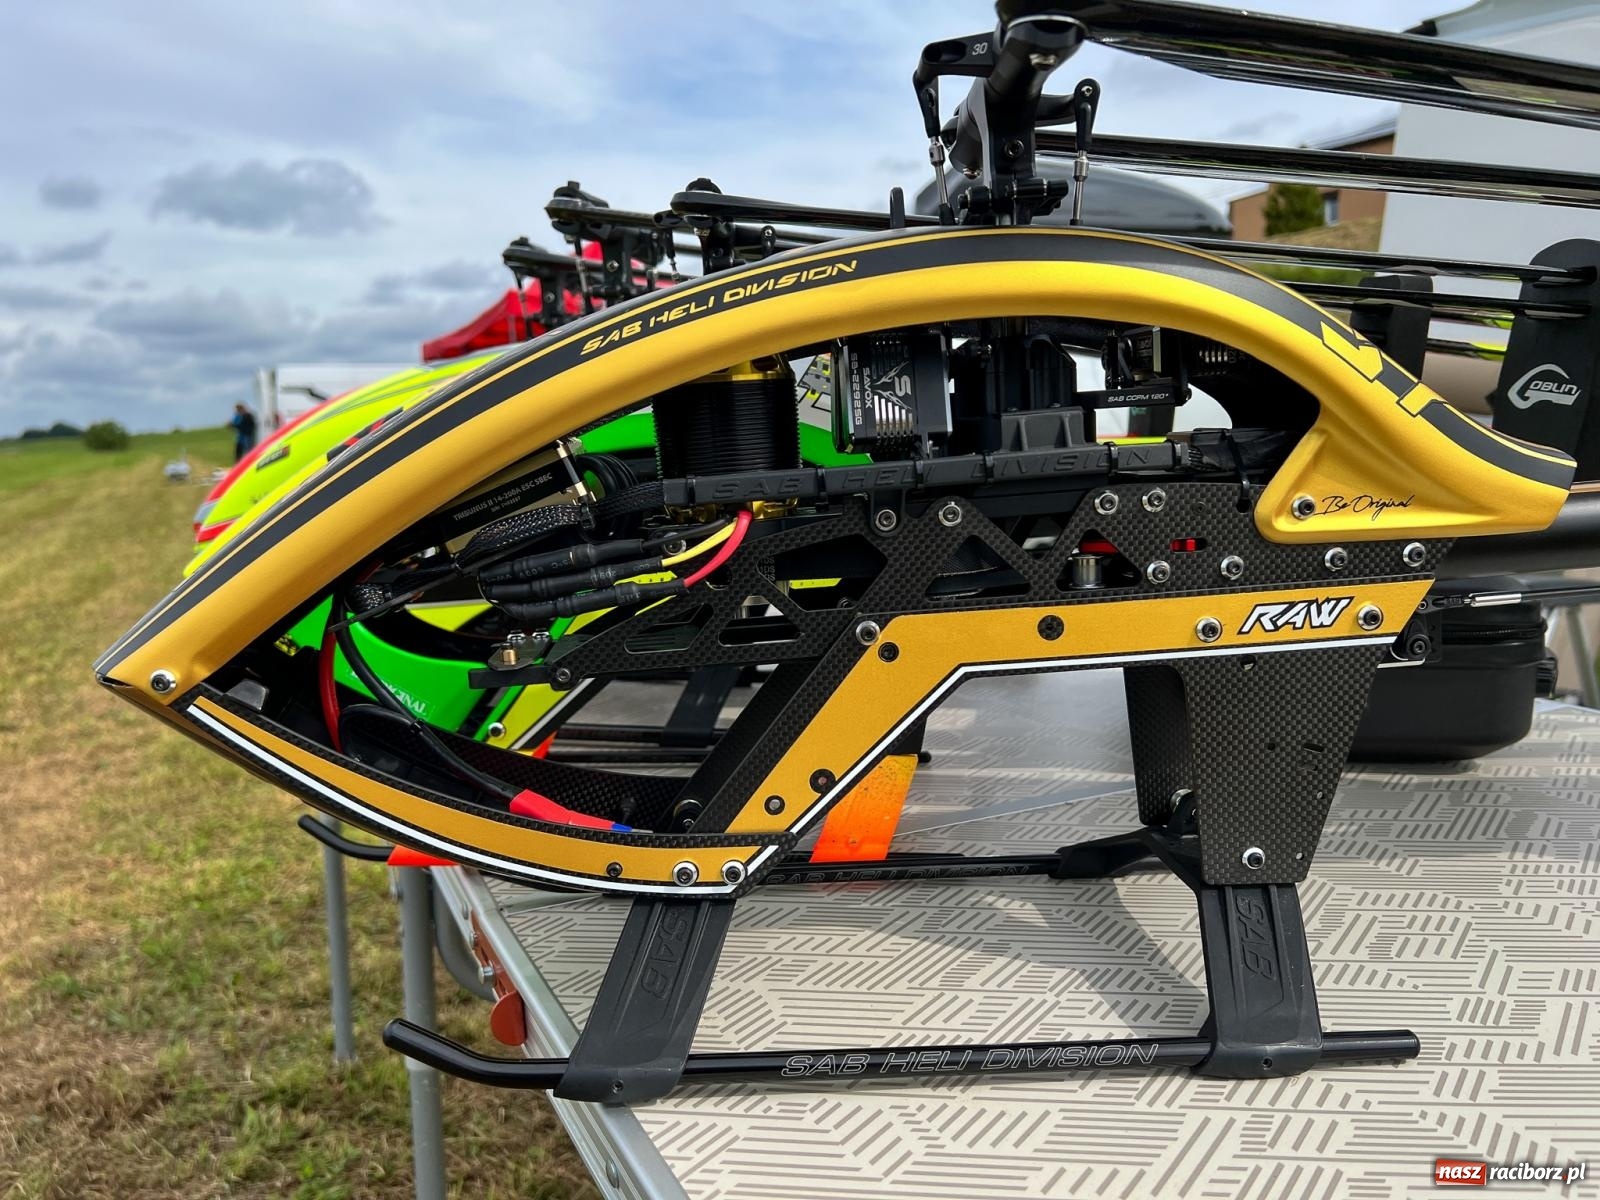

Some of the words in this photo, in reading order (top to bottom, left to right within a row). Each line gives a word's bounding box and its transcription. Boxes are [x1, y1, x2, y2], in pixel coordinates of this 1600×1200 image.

[971, 42, 988, 56] 30
[580, 320, 642, 356] SAB
[649, 296, 715, 328] HELI
[723, 260, 858, 304] DIVISION
[1108, 395, 1125, 403] SAB
[1126, 394, 1150, 402] CCPM
[1314, 495, 1351, 516] Be
[1350, 494, 1415, 521] Original
[1238, 596, 1355, 635] RAW
[640, 905, 689, 1000] SAB
[1235, 895, 1277, 981] SAB
[781, 1053, 870, 1077] SAB
[879, 1049, 972, 1073] HELI
[981, 1044, 1159, 1070] DIVISION
